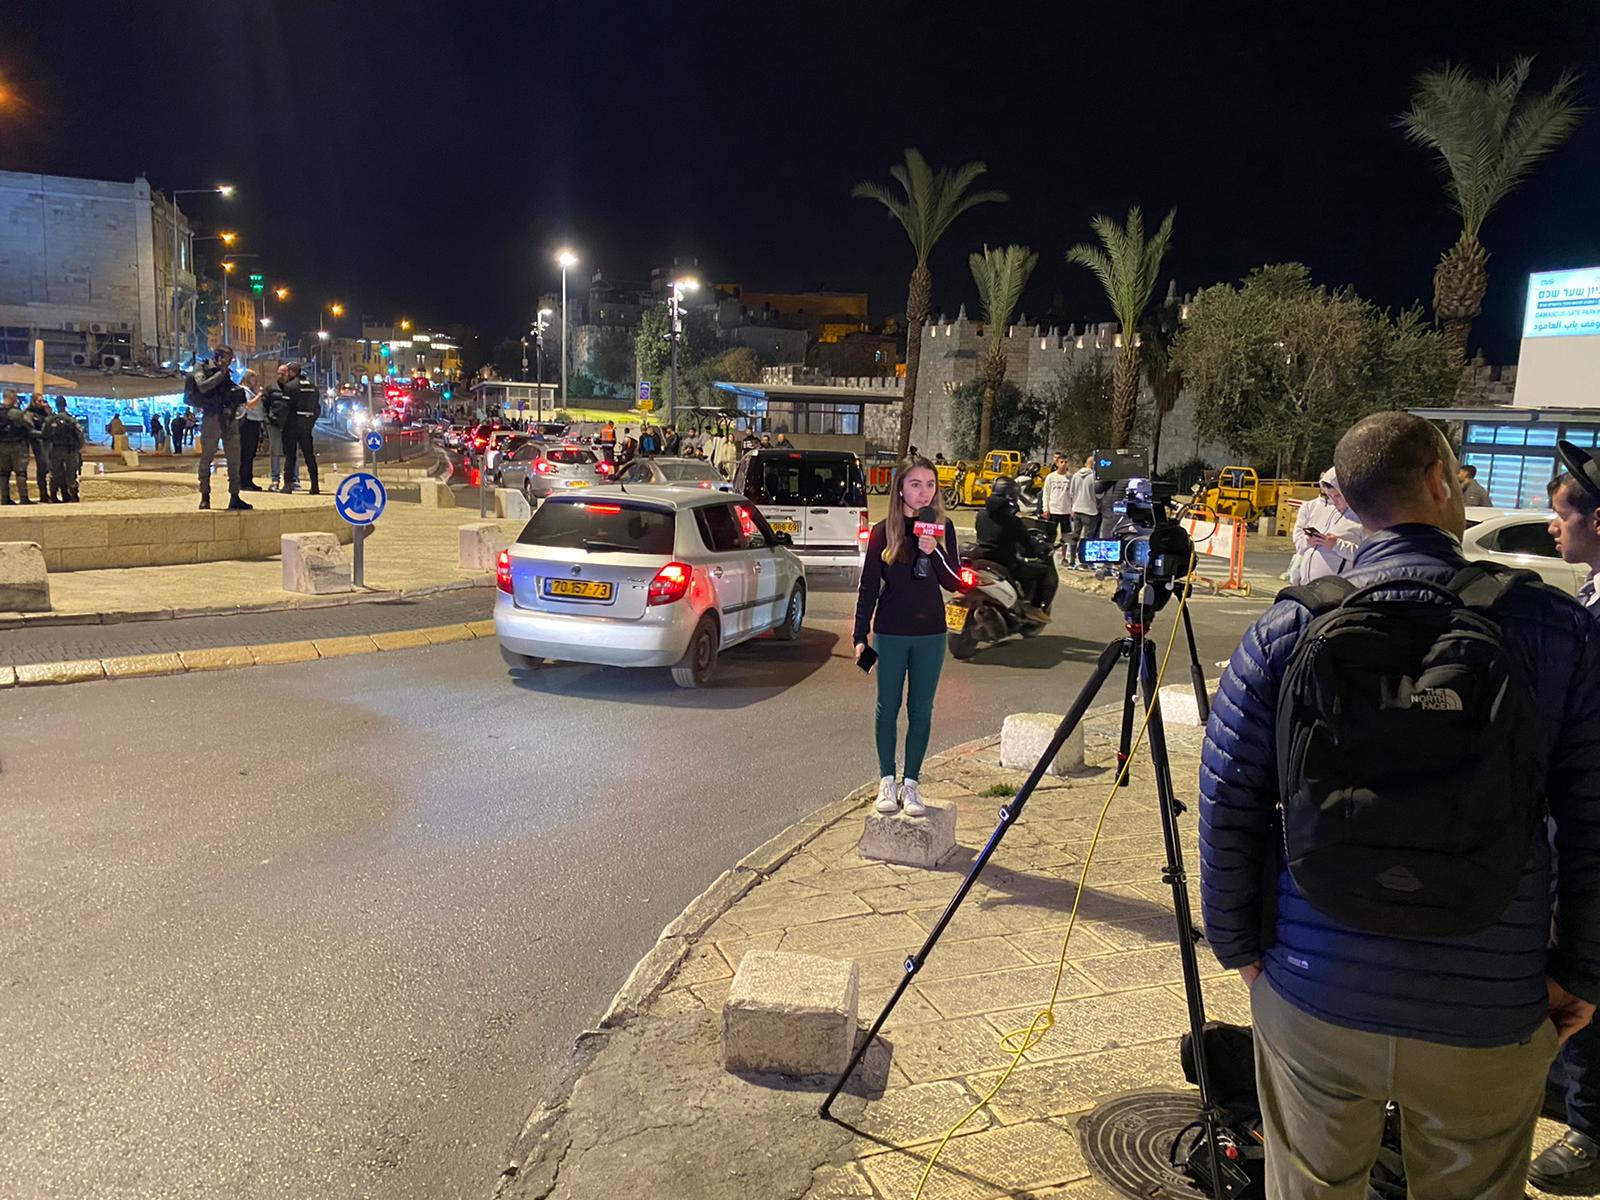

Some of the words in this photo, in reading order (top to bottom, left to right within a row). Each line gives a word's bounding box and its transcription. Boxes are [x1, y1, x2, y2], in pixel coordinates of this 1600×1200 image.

[1538, 289, 1560, 299] שכם
[1563, 287, 1584, 297] שער
[1425, 687, 1445, 696] THE
[1410, 694, 1446, 703] NORTH
[1422, 702, 1447, 710] FACE
